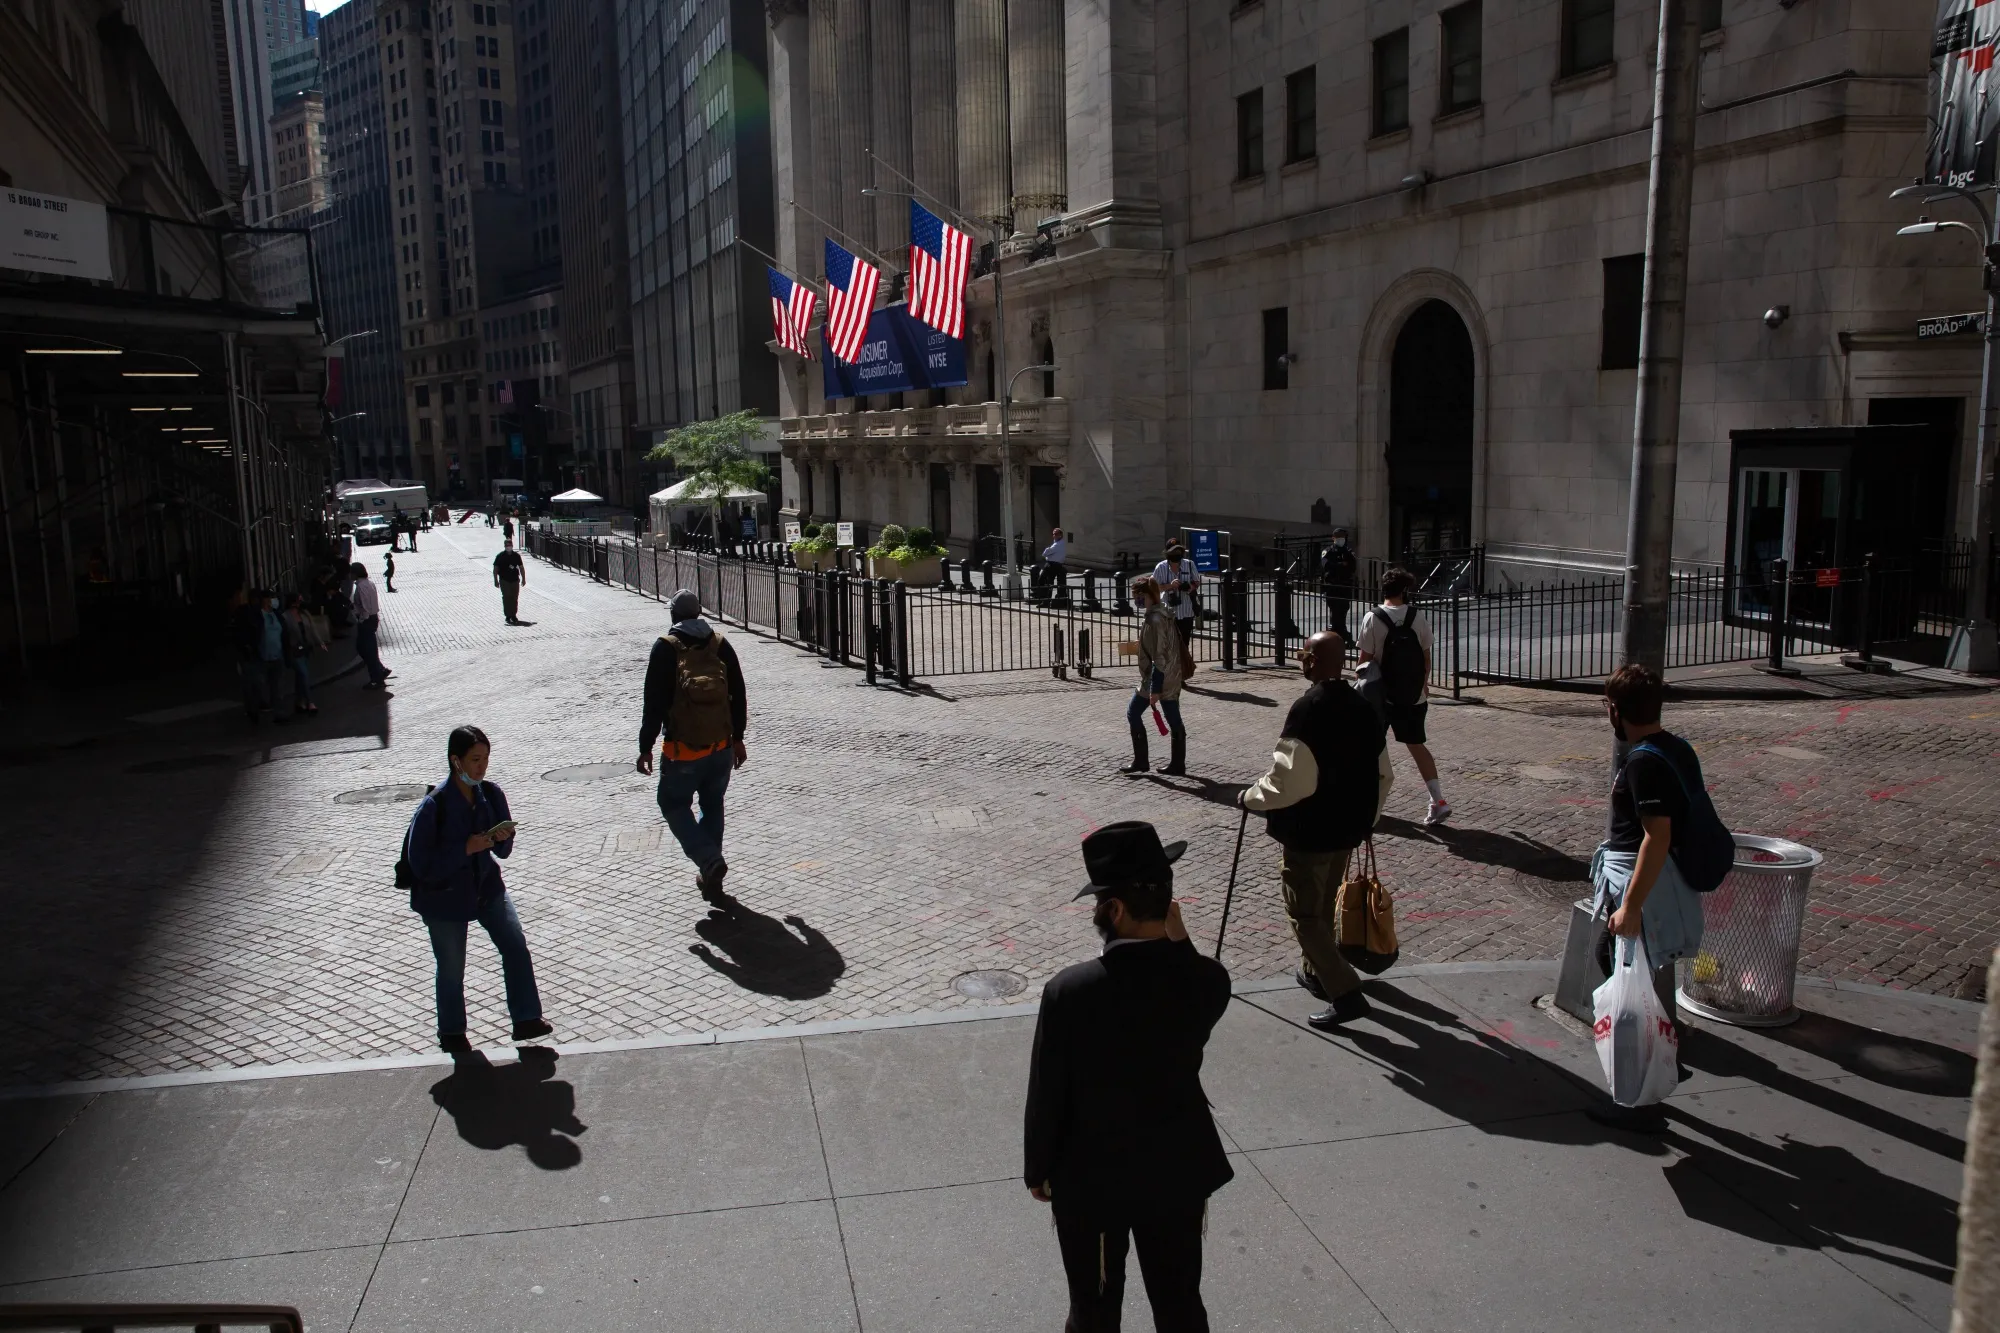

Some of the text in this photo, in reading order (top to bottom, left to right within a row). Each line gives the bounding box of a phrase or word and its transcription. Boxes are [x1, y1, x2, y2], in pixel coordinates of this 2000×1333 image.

[1936, 31, 1958, 41] CAPITAL
[1938, 21, 1968, 34] FINANCIAL
[1947, 169, 1975, 188] bgc
[8, 193, 68, 213] 15 BROAD STREET
[1919, 321, 1959, 336] BROAD
[1958, 319, 1967, 327] ST
[927, 333, 946, 346] LISTED
[856, 340, 888, 364] ONSUMER
[928, 352, 948, 369] NYSE
[858, 361, 904, 382] Acquisition Corp.
